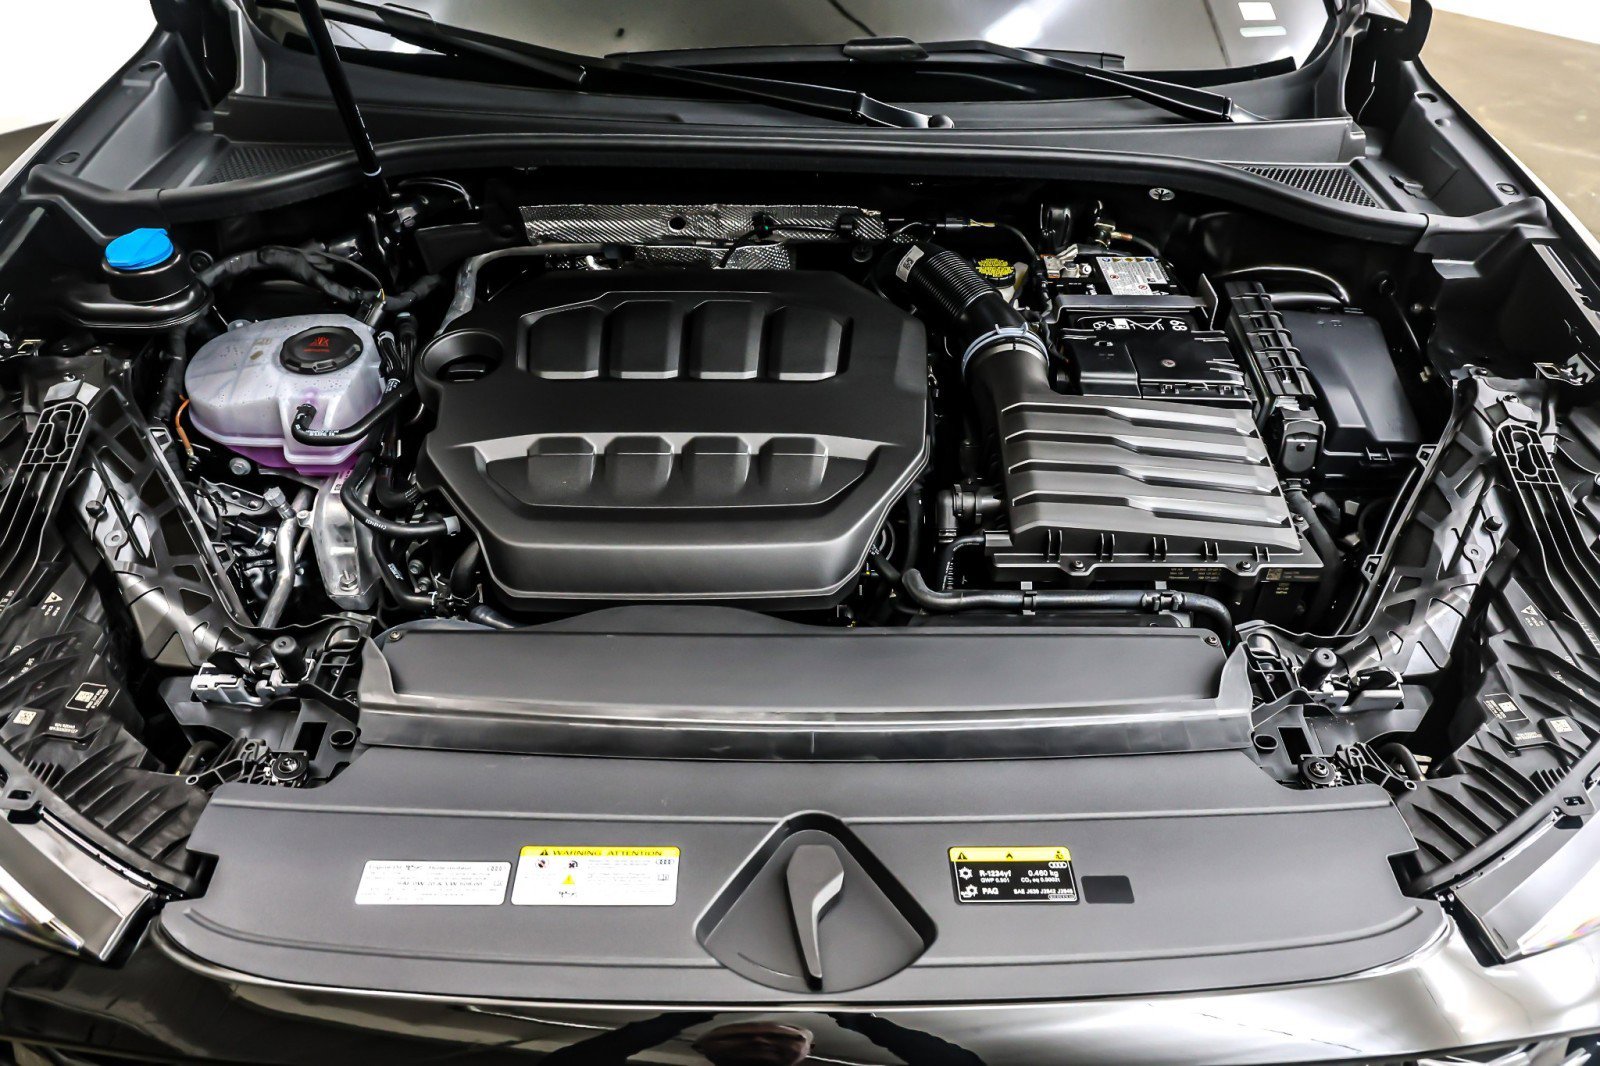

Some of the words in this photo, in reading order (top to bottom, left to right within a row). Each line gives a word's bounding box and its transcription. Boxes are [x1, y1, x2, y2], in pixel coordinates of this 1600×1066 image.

[979, 869, 1012, 878] R-1234yf
[1049, 869, 1059, 877] kg
[981, 887, 999, 895] PAG
